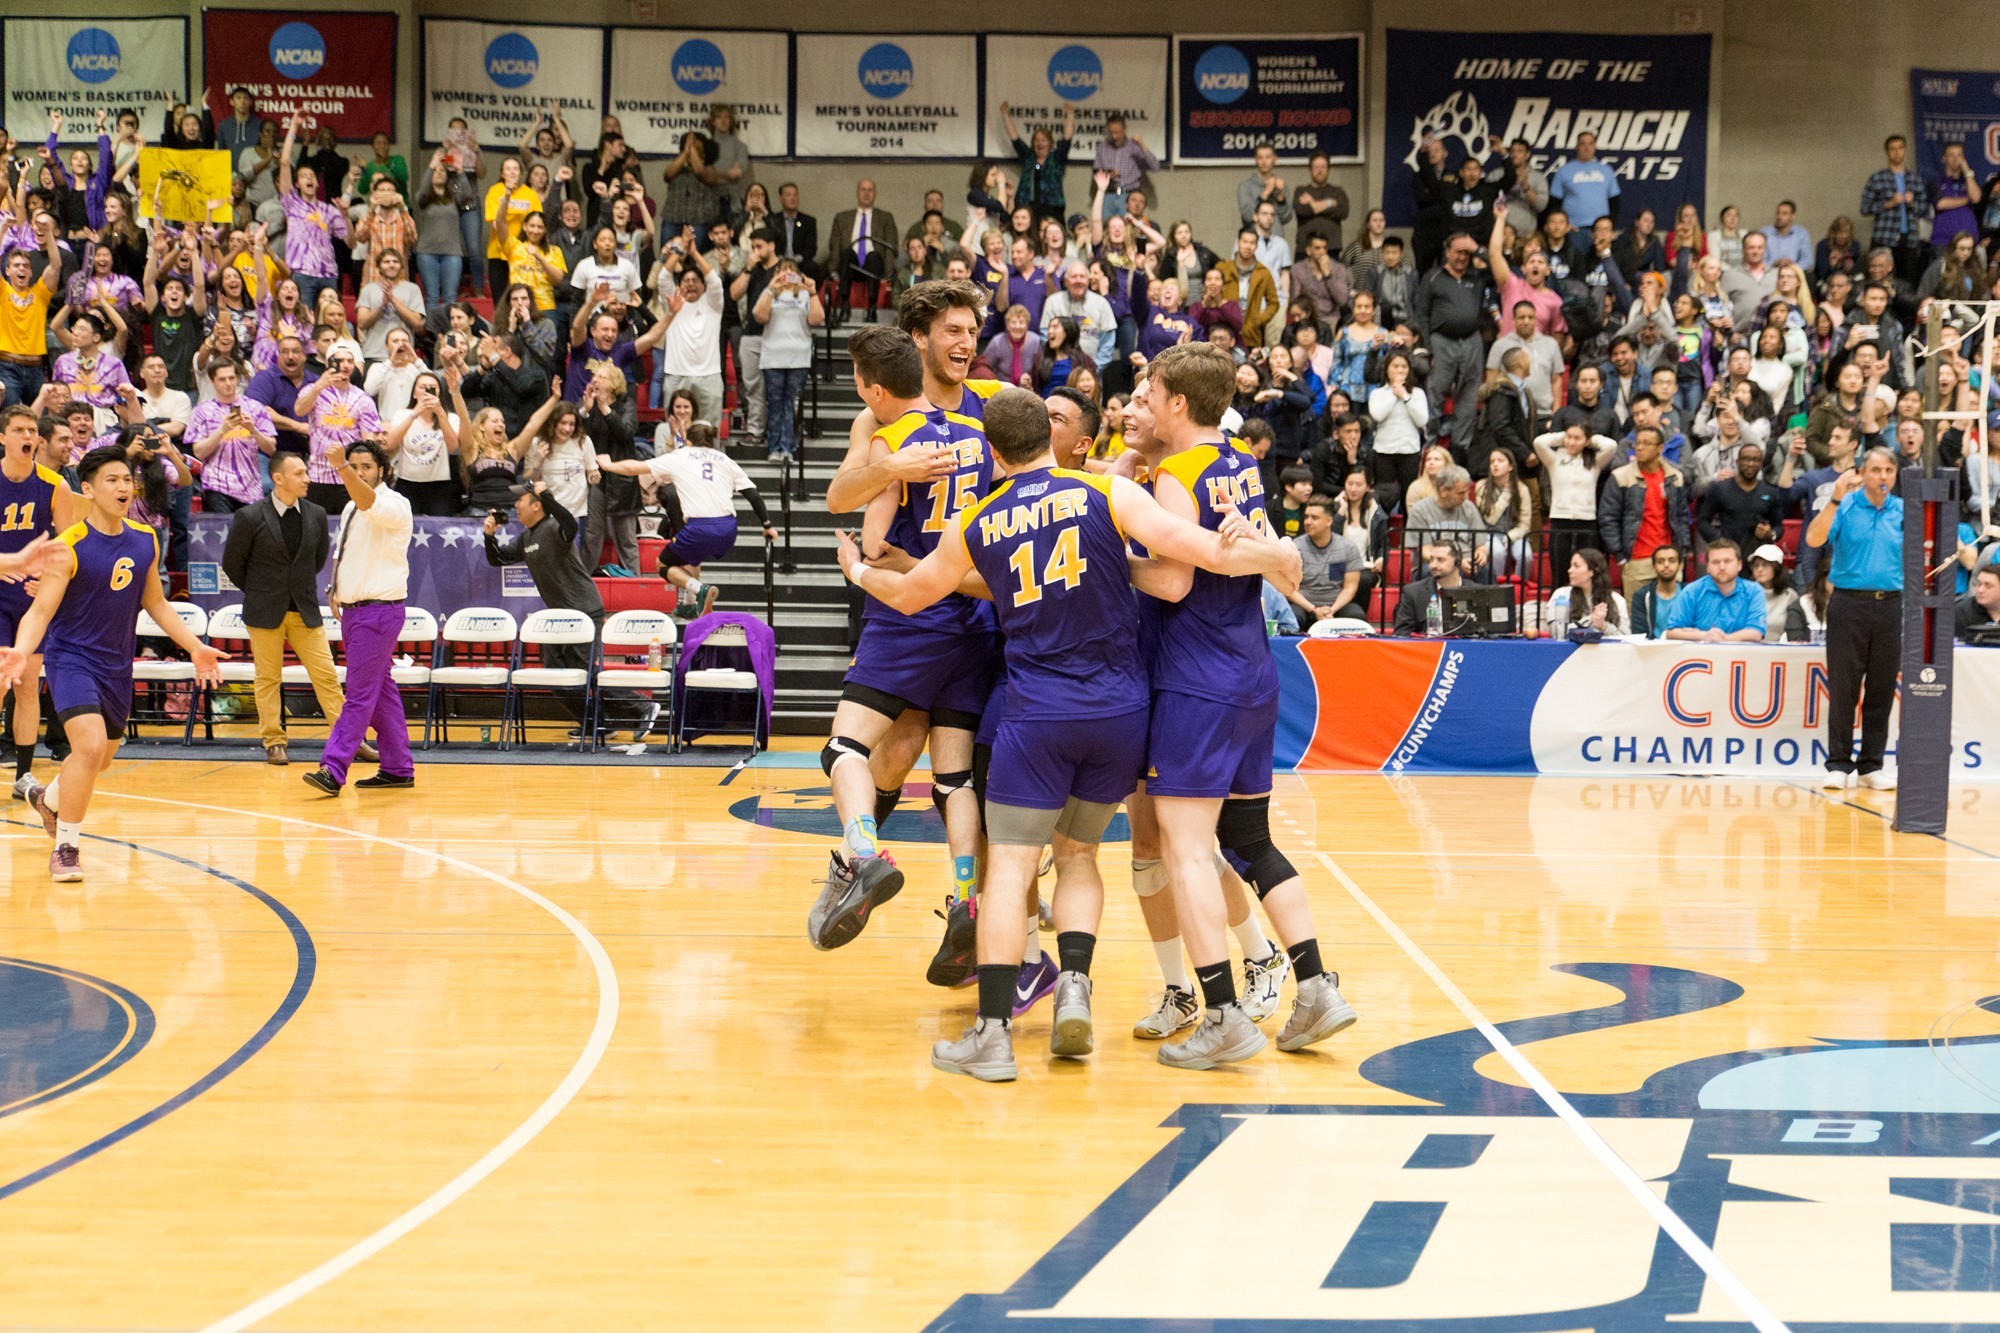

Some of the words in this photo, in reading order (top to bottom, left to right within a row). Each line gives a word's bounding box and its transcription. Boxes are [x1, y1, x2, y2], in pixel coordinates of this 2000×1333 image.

[72, 54, 119, 71] NCAA
[275, 48, 324, 65] NCAA
[1257, 55, 1318, 68] WOMEN'S
[489, 58, 538, 75] NCAA
[676, 65, 724, 82] NCAA
[1256, 68, 1338, 82] BASKETBALL
[1453, 57, 1543, 80] HOME
[1546, 58, 1590, 81] OF
[1595, 60, 1654, 83] THE
[864, 69, 911, 86] NCAA
[1053, 71, 1103, 88] NCAA
[1199, 72, 1248, 91] NCAA
[12, 90, 81, 102] WOMEN'S
[86, 90, 180, 102] BASKETBALL
[277, 84, 374, 98] VOLLEYBALL
[1256, 80, 1345, 95] TOURNAMENT
[431, 90, 498, 105] WOMEN'S
[254, 100, 298, 114] FINAL
[303, 101, 344, 115] FOUR
[616, 101, 684, 114] WOMEN'S
[815, 105, 861, 117] MEN'S
[866, 106, 959, 118] VOLLEYBALL
[1189, 110, 1274, 128] SECOND
[1278, 107, 1352, 127] ROUND
[1502, 96, 1691, 152] BARUCH
[836, 121, 939, 134] TOURNAMENT
[870, 137, 904, 149] 2014
[688, 450, 725, 462] HUNTER
[475, 458, 515, 474] HUNTER
[702, 461, 713, 482] 2
[1017, 481, 1049, 499] CUNY
[921, 471, 980, 533] 15
[1, 502, 35, 531] 11
[979, 487, 1088, 547] HUNTER
[110, 556, 135, 592] 6
[1009, 525, 1087, 608] 14
[456, 617, 506, 632] BARUCH
[533, 619, 583, 634] BARUCH
[613, 619, 665, 634] BARUCH
[1663, 659, 1902, 729] CUN
[1391, 650, 1464, 771] #CUNYCHAMPS
[1580, 735, 1982, 769] CHAMPIONS
